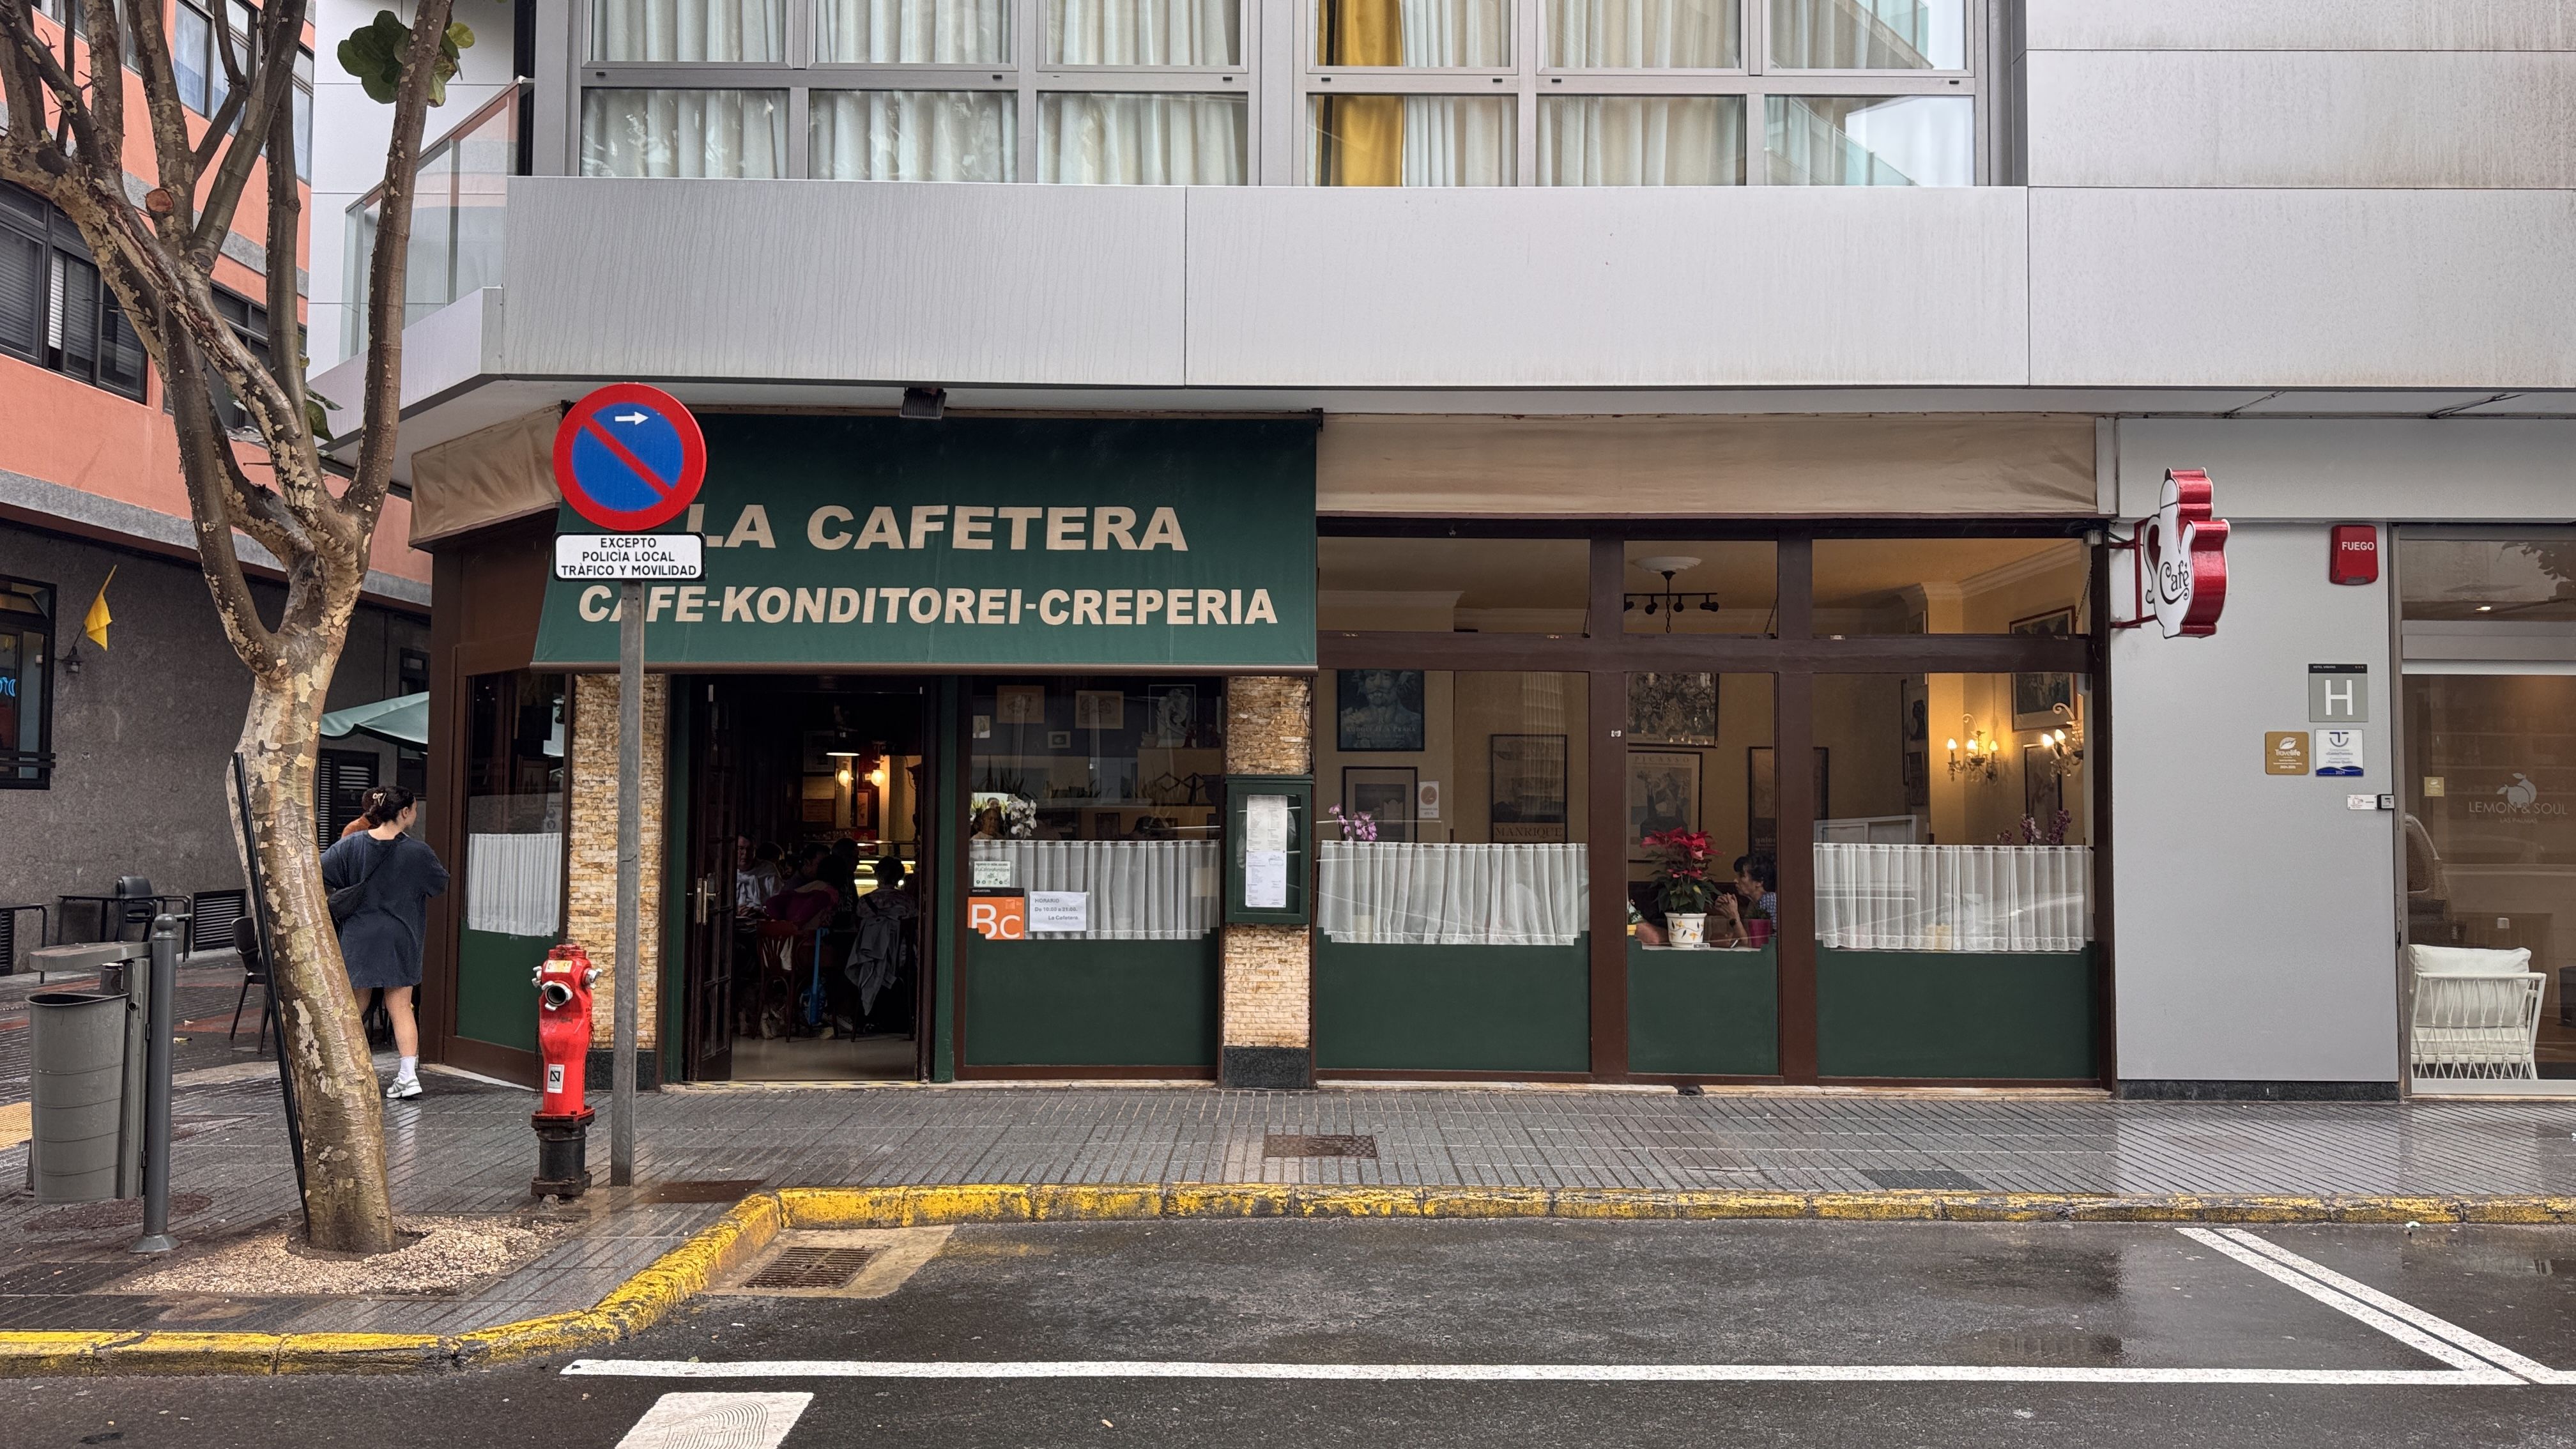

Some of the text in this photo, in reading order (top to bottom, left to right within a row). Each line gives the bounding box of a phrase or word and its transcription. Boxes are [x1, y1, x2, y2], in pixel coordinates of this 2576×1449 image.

[686, 503, 1189, 551] LA CAFETERA
[601, 538, 656, 548] EXCEPTO
[2342, 541, 2375, 551] FUEGO
[635, 551, 675, 562] LOCAL
[619, 565, 627, 575] Y
[632, 565, 696, 575] MOVILIDAD
[2159, 560, 2190, 605] Café
[2325, 679, 2353, 716] H
[2469, 801, 2568, 815] LEMON & SOUL
[1496, 827, 1562, 838] MANRIQUE
[971, 904, 1020, 939] Bc
